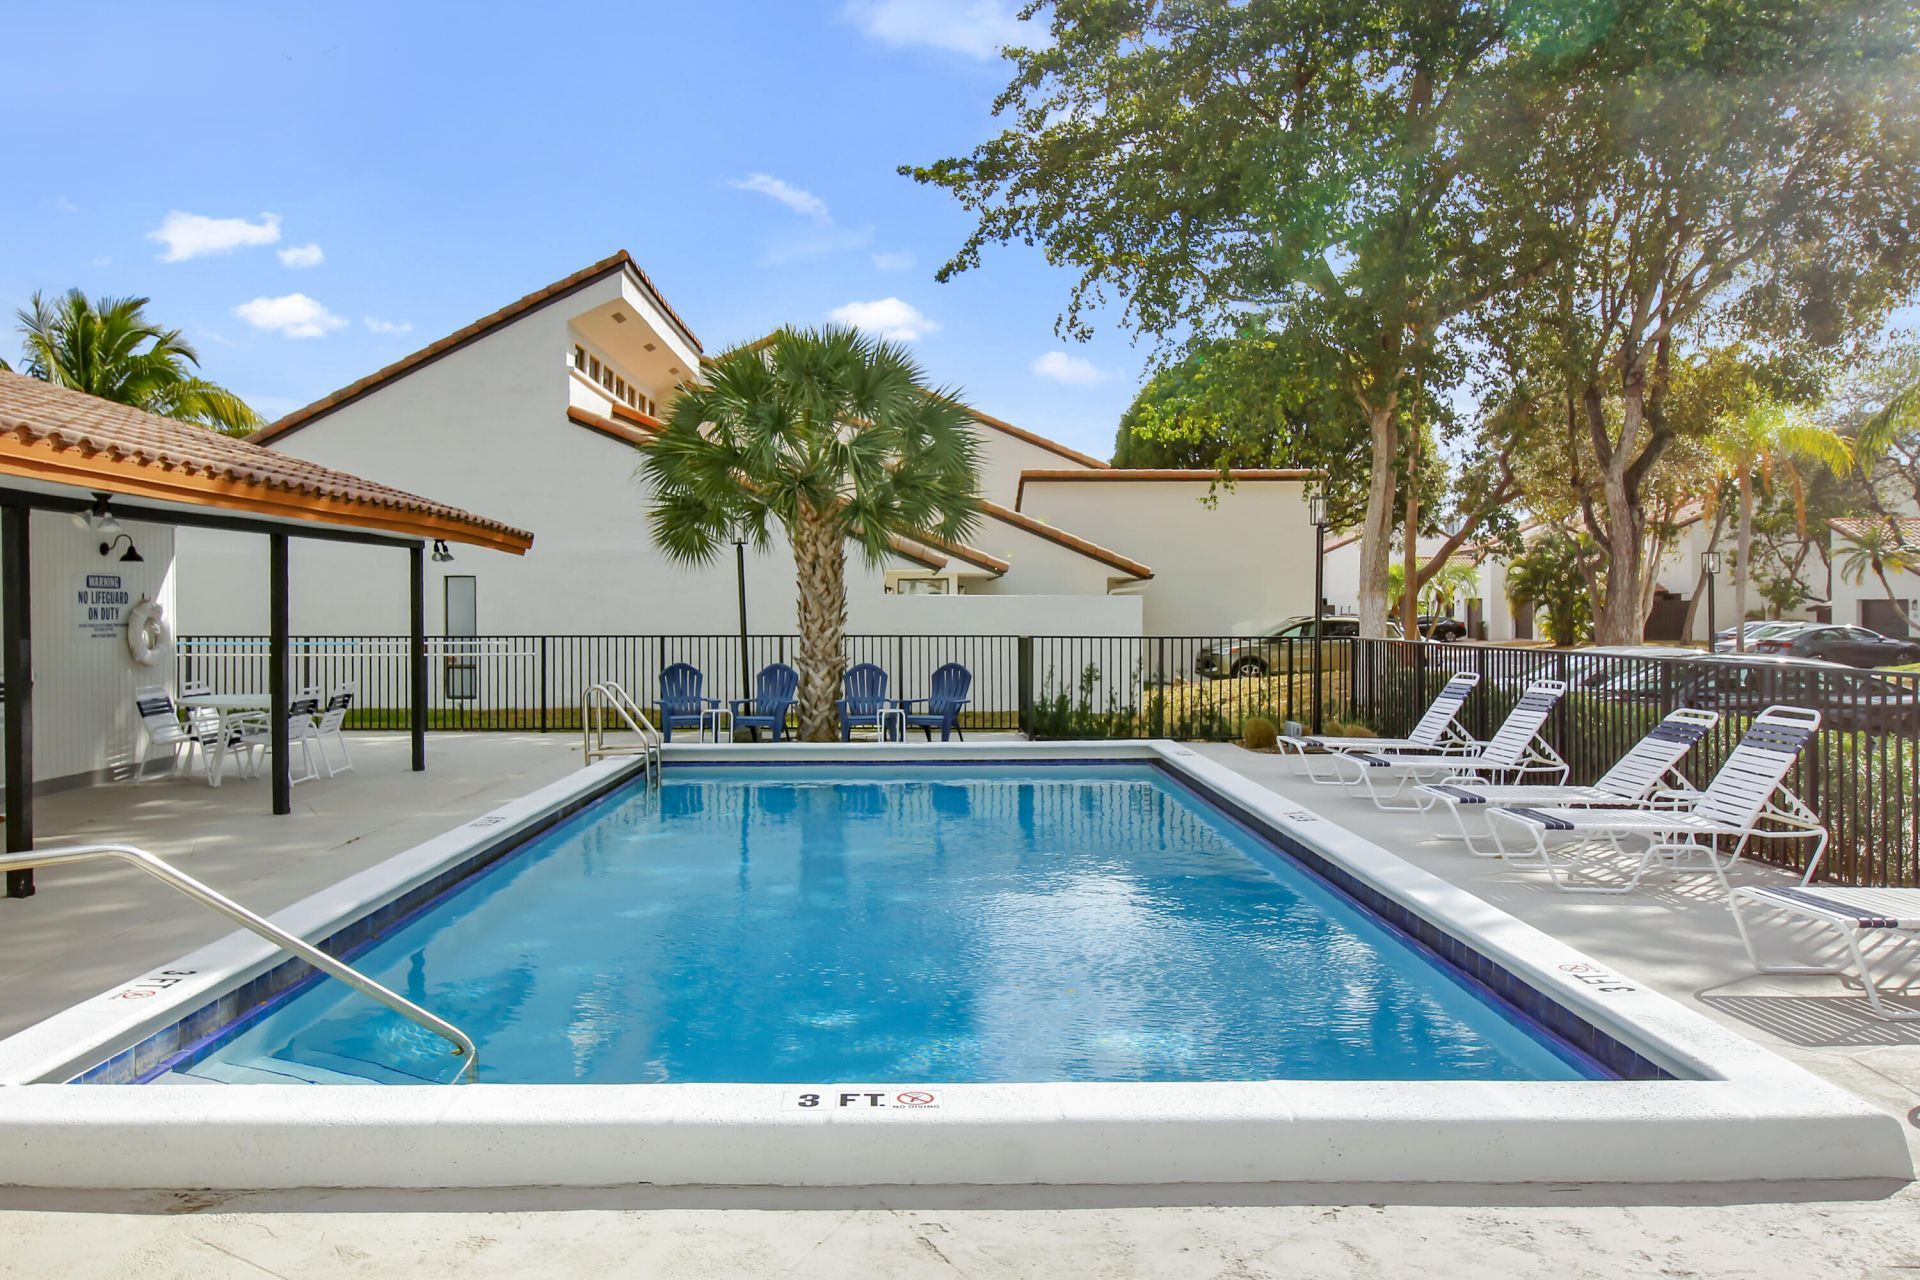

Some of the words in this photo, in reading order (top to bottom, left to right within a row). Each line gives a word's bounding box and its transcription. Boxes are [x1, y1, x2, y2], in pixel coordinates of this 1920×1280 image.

[88, 576, 120, 588] WARNING
[78, 591, 88, 604] NO
[91, 591, 129, 604] LIFEGUARD
[88, 607, 98, 620] ON
[101, 607, 119, 620] DUTY
[798, 1093, 820, 1107] 3
